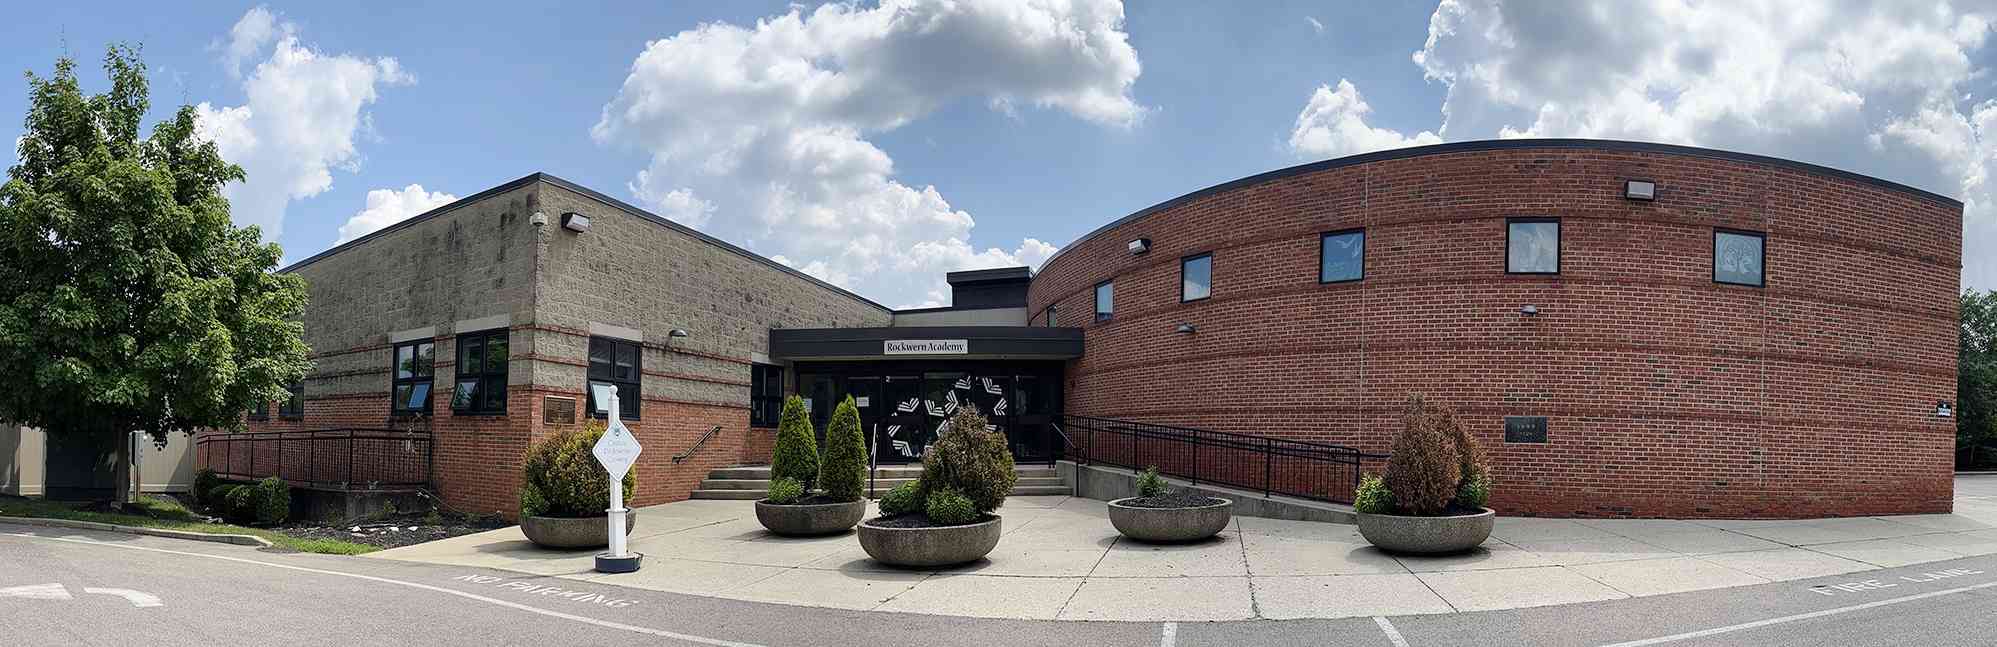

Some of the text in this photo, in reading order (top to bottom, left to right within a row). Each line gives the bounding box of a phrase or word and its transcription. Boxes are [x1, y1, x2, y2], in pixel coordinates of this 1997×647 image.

[887, 341, 964, 353] Rockwern Academy
[456, 573, 640, 608] NO PARKING
[1808, 568, 1985, 595] FIRE LANE
